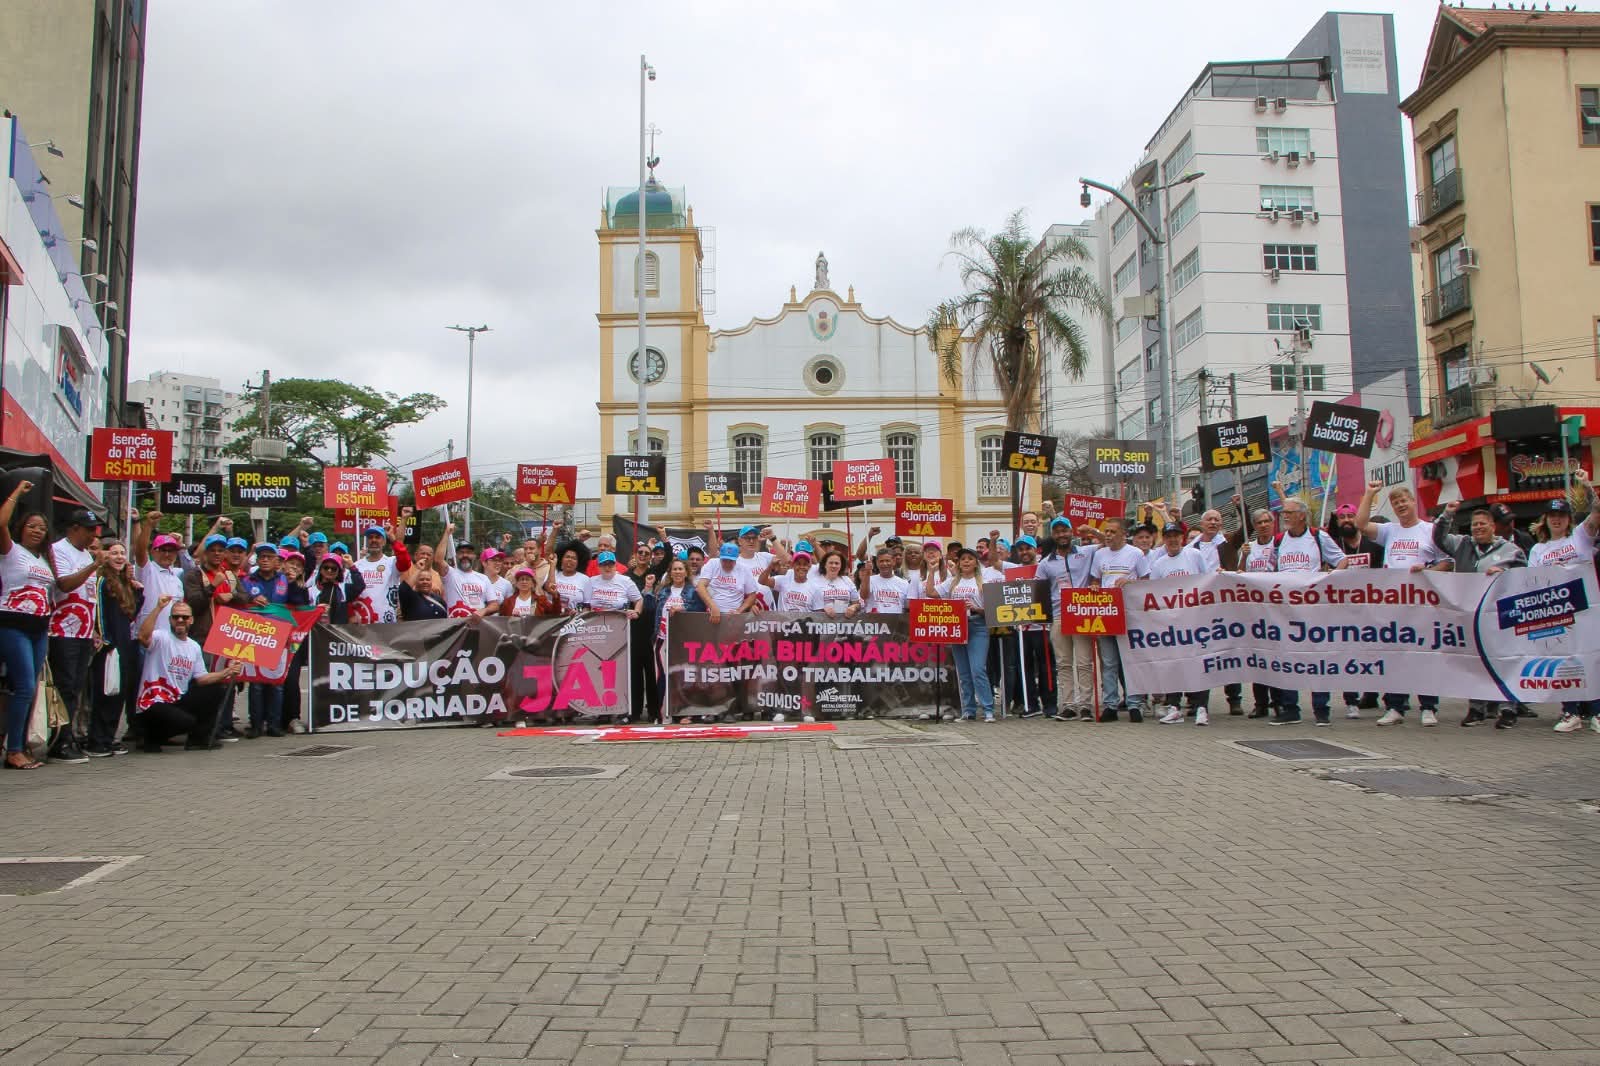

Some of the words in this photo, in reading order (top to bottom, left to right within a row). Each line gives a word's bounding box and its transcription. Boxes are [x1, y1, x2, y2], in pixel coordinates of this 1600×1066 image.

[1326, 411, 1359, 430] Juros
[1217, 426, 1234, 437] Fim
[1236, 423, 1248, 434] da
[1313, 424, 1349, 443] baixos
[1351, 429, 1368, 448] já!
[112, 432, 154, 448] Isenção
[1019, 435, 1032, 446] Fim
[1033, 436, 1042, 447] da
[1219, 434, 1249, 448] Escala
[108, 446, 122, 458] do
[125, 446, 136, 459] IR
[139, 446, 157, 460] até
[1018, 445, 1040, 456] Escala
[1096, 448, 1120, 462] PPR
[1123, 450, 1150, 463] sem
[1212, 442, 1265, 467] 6x1
[623, 458, 639, 468] Fim
[639, 458, 649, 468] da
[847, 462, 880, 475] Isenção
[1009, 452, 1049, 473] 6x1
[1099, 460, 1146, 477] imposto
[236, 472, 261, 487] PPR
[264, 474, 290, 487] sem
[340, 471, 374, 483] Isenção
[421, 469, 461, 486] Diversidade
[522, 466, 554, 478] Redução
[624, 468, 649, 477] Escala
[704, 474, 717, 483] Fim
[718, 474, 728, 483] da
[845, 473, 856, 484] do
[858, 472, 867, 483] IR
[869, 471, 883, 483] até
[176, 480, 207, 494] Juros
[337, 481, 349, 491] do
[351, 481, 360, 491] IR
[362, 481, 376, 492] até
[420, 489, 427, 497] e
[427, 478, 466, 497] igualdade
[523, 476, 537, 485] dos
[537, 476, 557, 487] juros
[615, 476, 660, 493] 6x1
[705, 483, 728, 491] Escala
[776, 480, 808, 493] Isenção
[167, 491, 201, 505] baixos
[202, 492, 216, 508] já!
[240, 485, 287, 501] imposto
[530, 482, 570, 503] JÁ
[698, 490, 738, 505] 6x1
[773, 491, 784, 501] do
[785, 491, 794, 501] IR
[795, 491, 809, 502] até
[359, 508, 390, 519] mposto
[905, 501, 943, 513] Redução
[1070, 507, 1084, 517] dos
[1085, 510, 1105, 520] juros
[341, 519, 354, 529] no
[908, 511, 946, 522] Jornada
[1003, 585, 1019, 595] Fim
[1020, 584, 1032, 594] da
[1004, 594, 1032, 605] Escala
[1072, 591, 1113, 606] Redução
[1143, 592, 1160, 612] A
[1161, 587, 1215, 610] vida
[1219, 583, 1264, 604] não
[1268, 583, 1284, 605] é
[1288, 583, 1320, 605] só
[1324, 583, 1441, 606] trabalho
[1514, 586, 1570, 610] REDUÇÃO
[922, 602, 953, 615] Isenção
[996, 602, 1047, 623] 6x1
[1066, 603, 1076, 613] de
[1074, 602, 1119, 616] Jornada
[1517, 600, 1576, 623] JORNADA
[229, 612, 277, 636] Redução
[917, 612, 927, 623] do
[1076, 614, 1107, 633] JÁ
[219, 623, 231, 634] de
[226, 625, 278, 649] Jornada
[743, 620, 803, 637] JUSTIÇA
[806, 620, 891, 635] TRIBUTÁRIA
[914, 627, 926, 638] no
[928, 624, 948, 638] PPR
[950, 624, 961, 638] Já
[1127, 617, 1245, 649] Redução
[1251, 618, 1281, 642] da
[1288, 620, 1425, 646] Jornada,
[1431, 620, 1467, 650] já!
[223, 642, 257, 663] JÁ
[683, 639, 771, 664] TAXAR
[776, 636, 947, 664] BILIONÁRIOS
[329, 650, 506, 694] REDUÇÃO
[1203, 655, 1241, 674] Fim
[1246, 653, 1267, 669] da
[1271, 660, 1340, 676] escala
[1344, 658, 1385, 676] 6x1
[520, 643, 619, 713] JÁ!
[684, 666, 697, 683] E
[701, 664, 778, 683] ISENTAR
[782, 665, 798, 681] O
[802, 667, 948, 683] TRABALHADOR
[829, 693, 863, 703] SMETAL
[329, 704, 360, 723] DE
[368, 692, 507, 722] JORNADA
